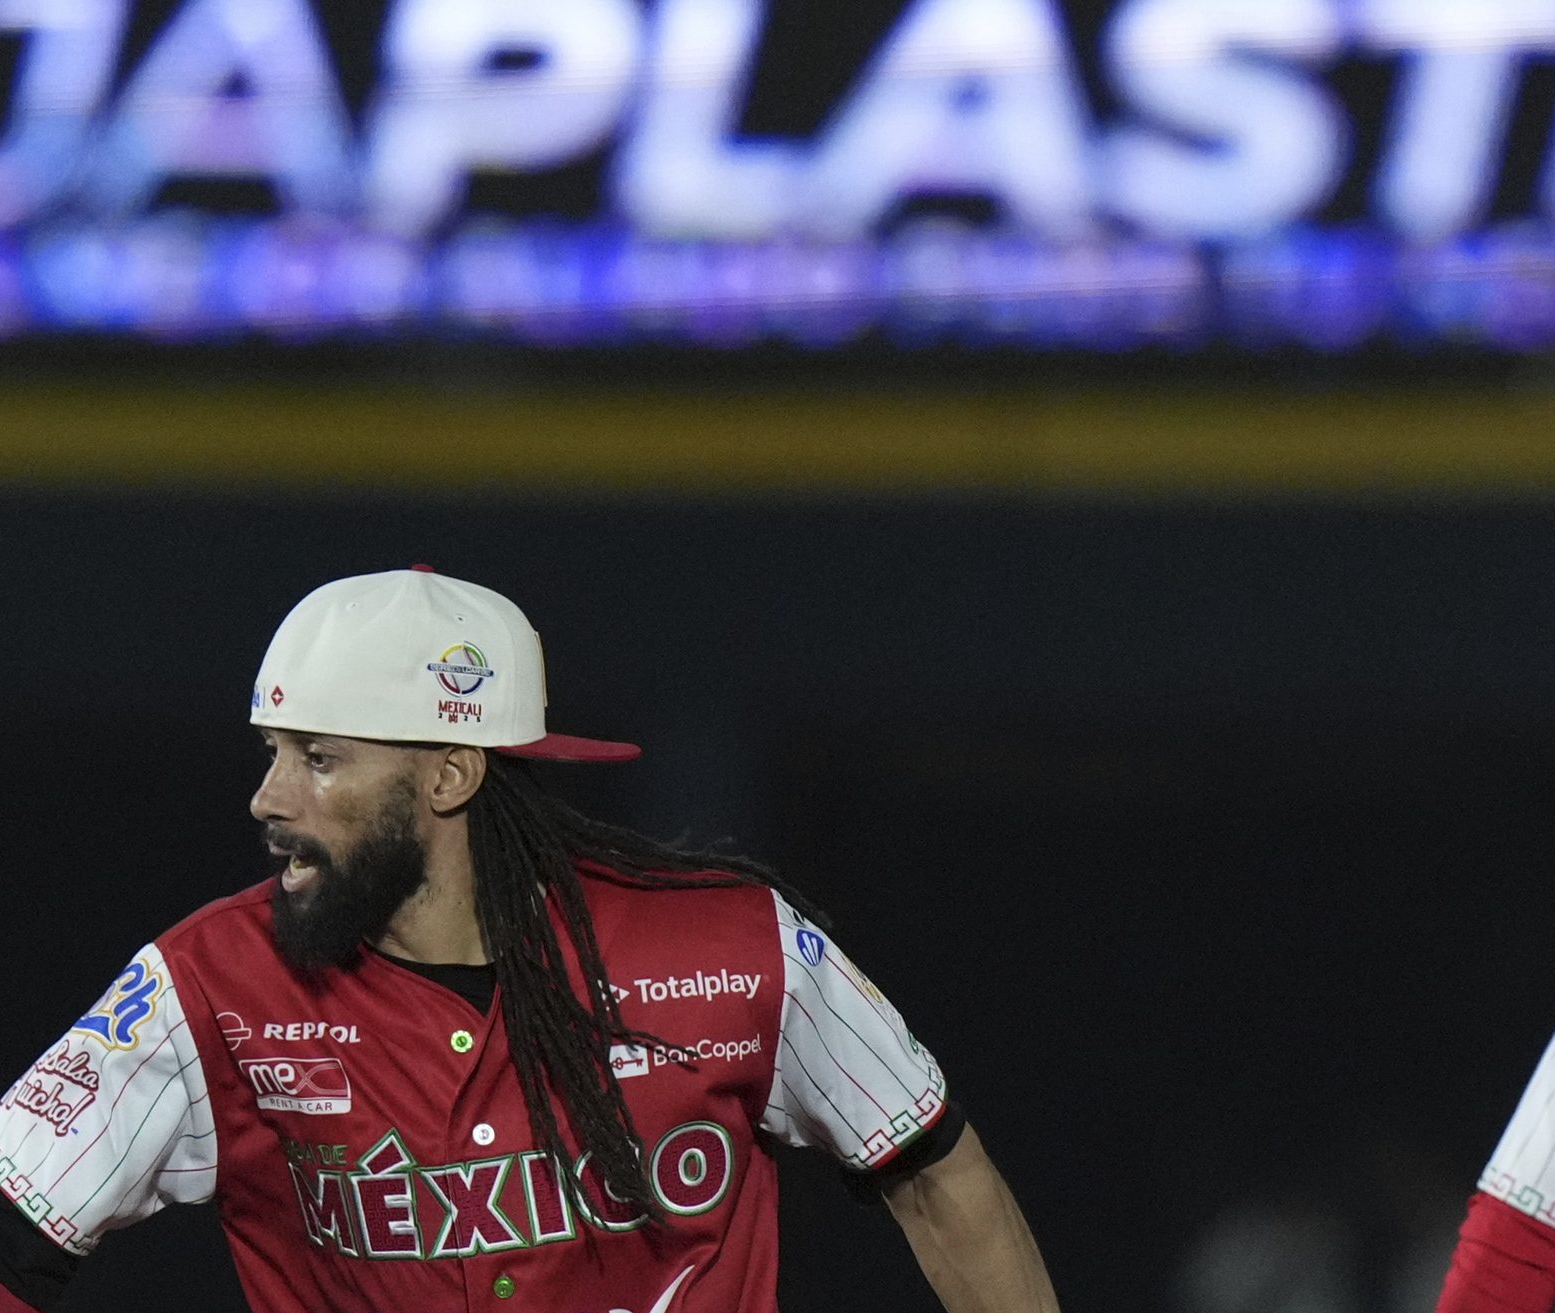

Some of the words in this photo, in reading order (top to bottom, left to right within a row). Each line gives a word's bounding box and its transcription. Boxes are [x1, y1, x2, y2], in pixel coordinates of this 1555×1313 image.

[438, 699, 481, 717] MEXICALI
[634, 969, 761, 1004] Totalplay
[653, 1033, 762, 1067] BanCoppel
[35, 1039, 100, 1093] Salsa
[306, 1101, 333, 1112] CAR
[318, 1144, 348, 1164] DE
